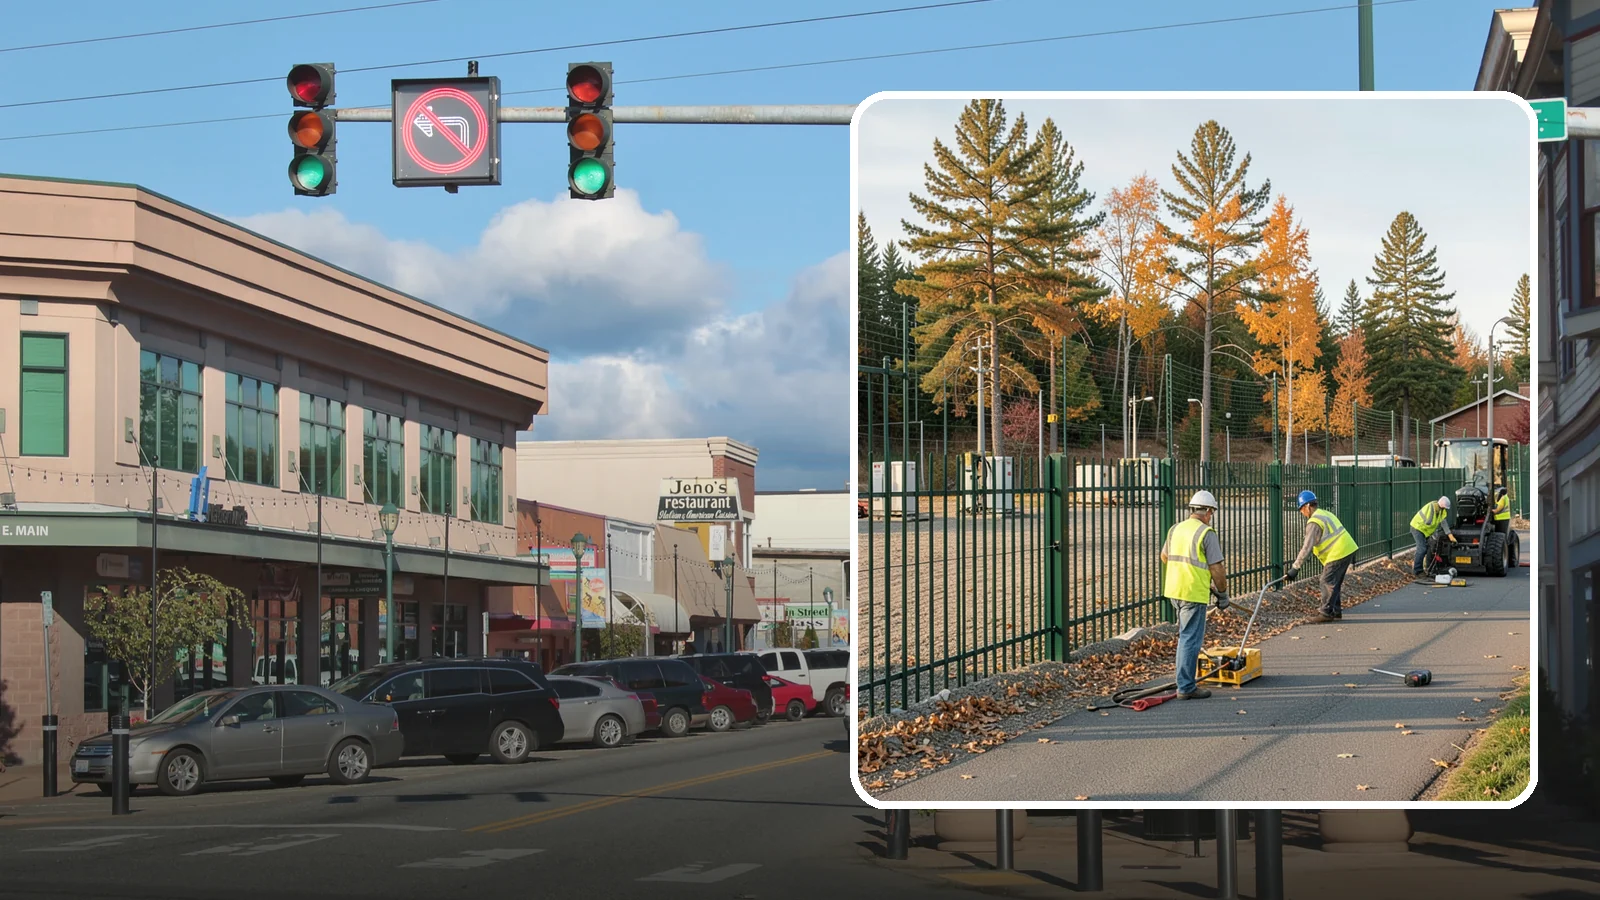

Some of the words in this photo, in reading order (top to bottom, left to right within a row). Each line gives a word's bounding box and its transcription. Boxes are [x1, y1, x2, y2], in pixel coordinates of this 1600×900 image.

[670, 480, 727, 494] Jeno's
[665, 496, 731, 509] restaurant
[658, 510, 682, 520] Italian
[686, 510, 714, 519] American
[714, 510, 737, 519] Cuisine
[2, 526, 13, 536] E.
[16, 526, 48, 536] MAIN
[798, 607, 828, 616] Street
